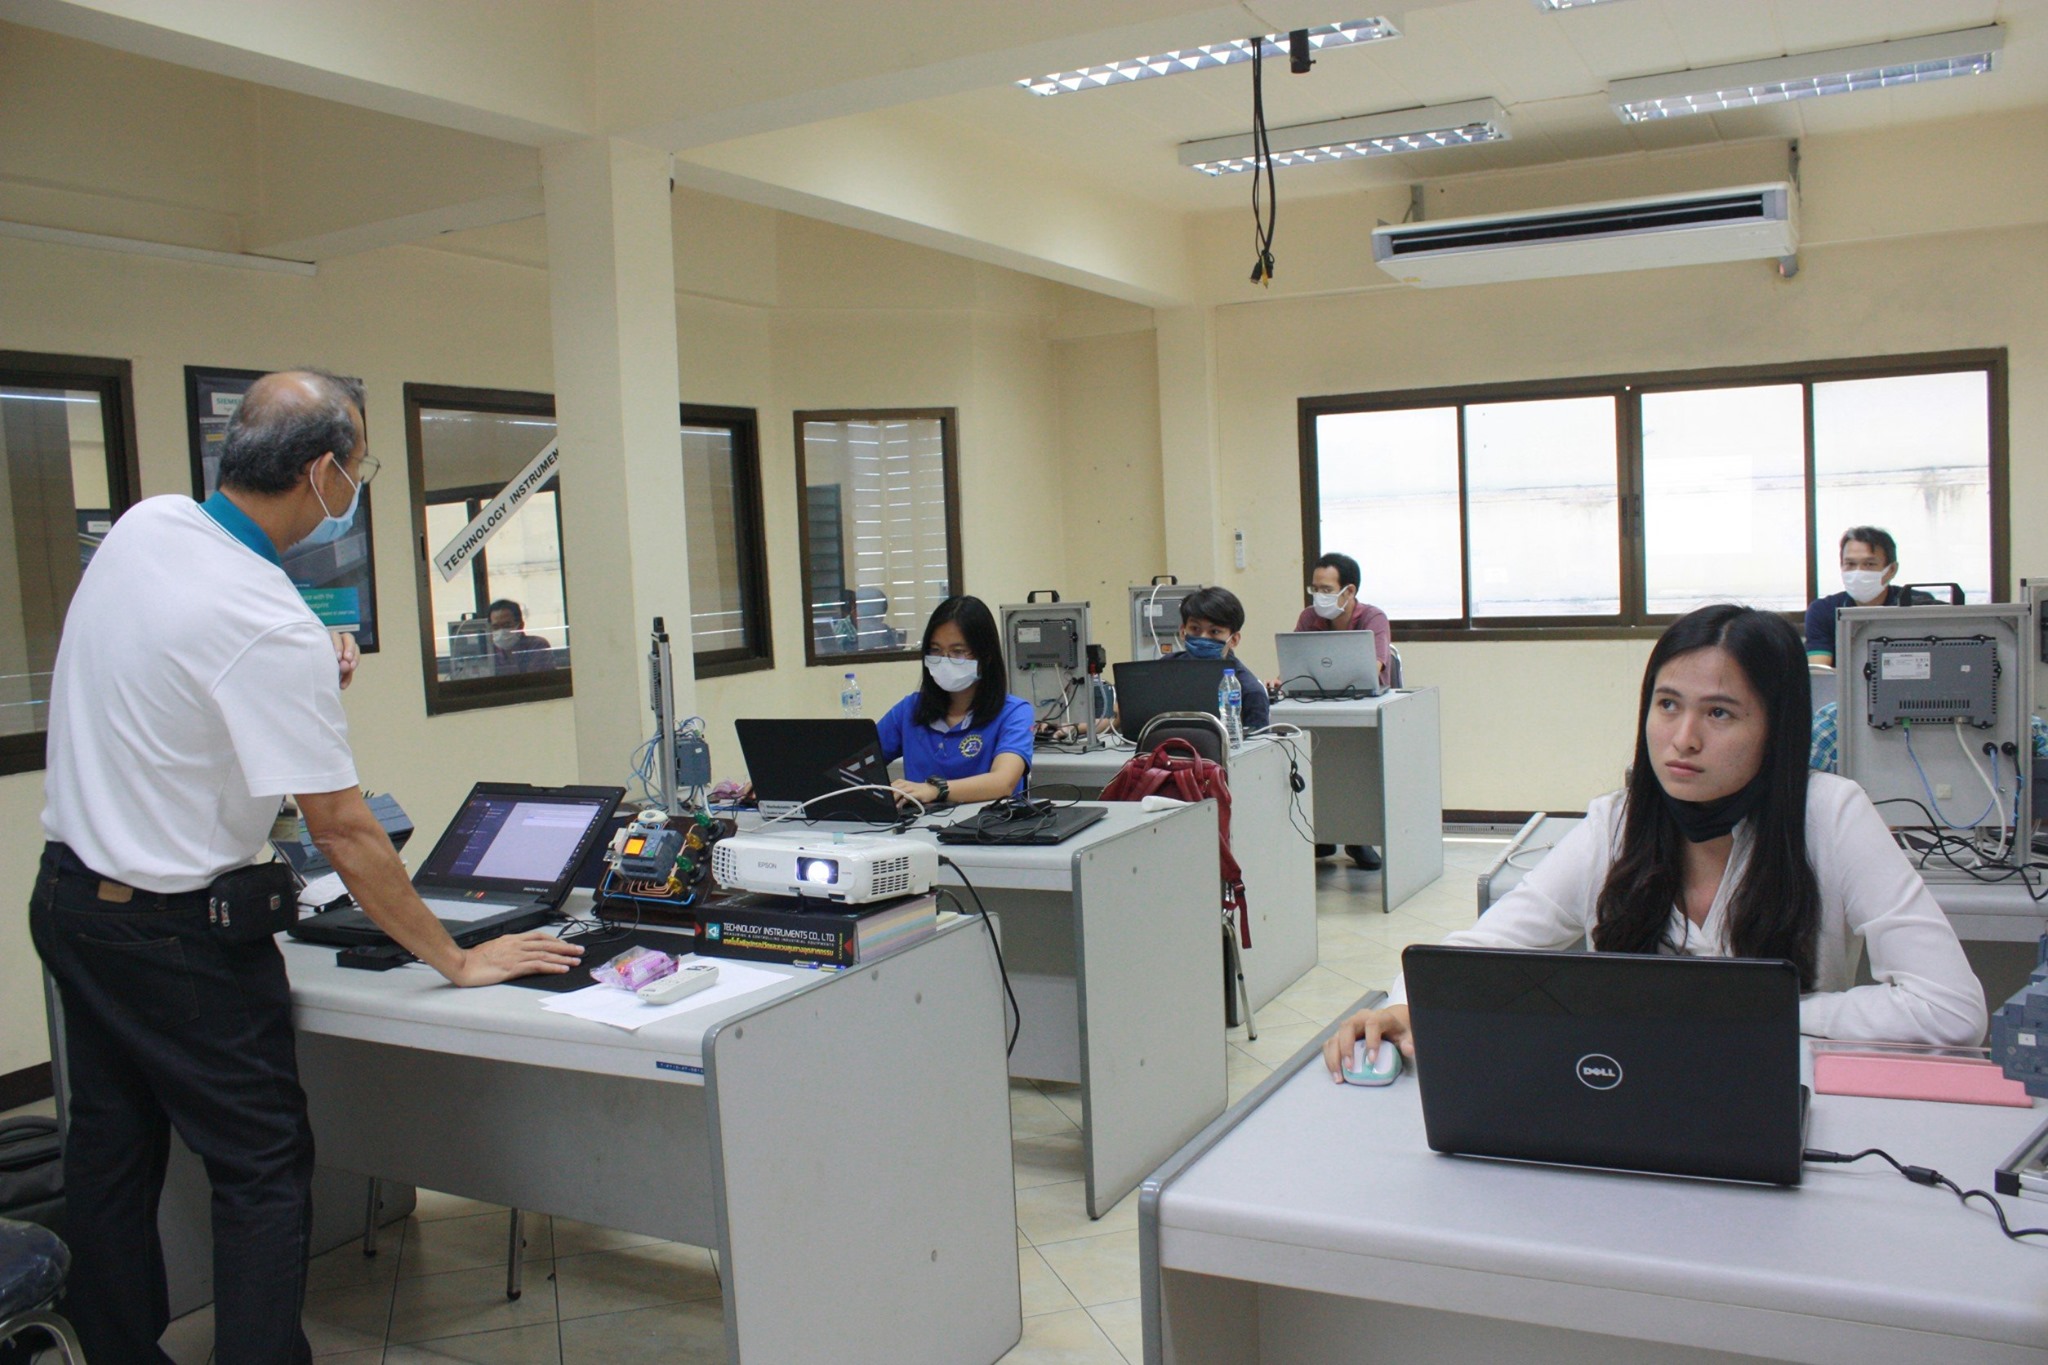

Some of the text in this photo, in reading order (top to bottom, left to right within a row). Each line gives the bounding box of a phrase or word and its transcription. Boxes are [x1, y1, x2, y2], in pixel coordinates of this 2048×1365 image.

[443, 448, 559, 571] TECHNOLOGY INSTRUMEN
[758, 861, 777, 869] EPSON
[723, 922, 762, 934] TECHNOLOGY
[763, 927, 808, 939] INSTRUMENTS
[1583, 1066, 1616, 1077] DELL
